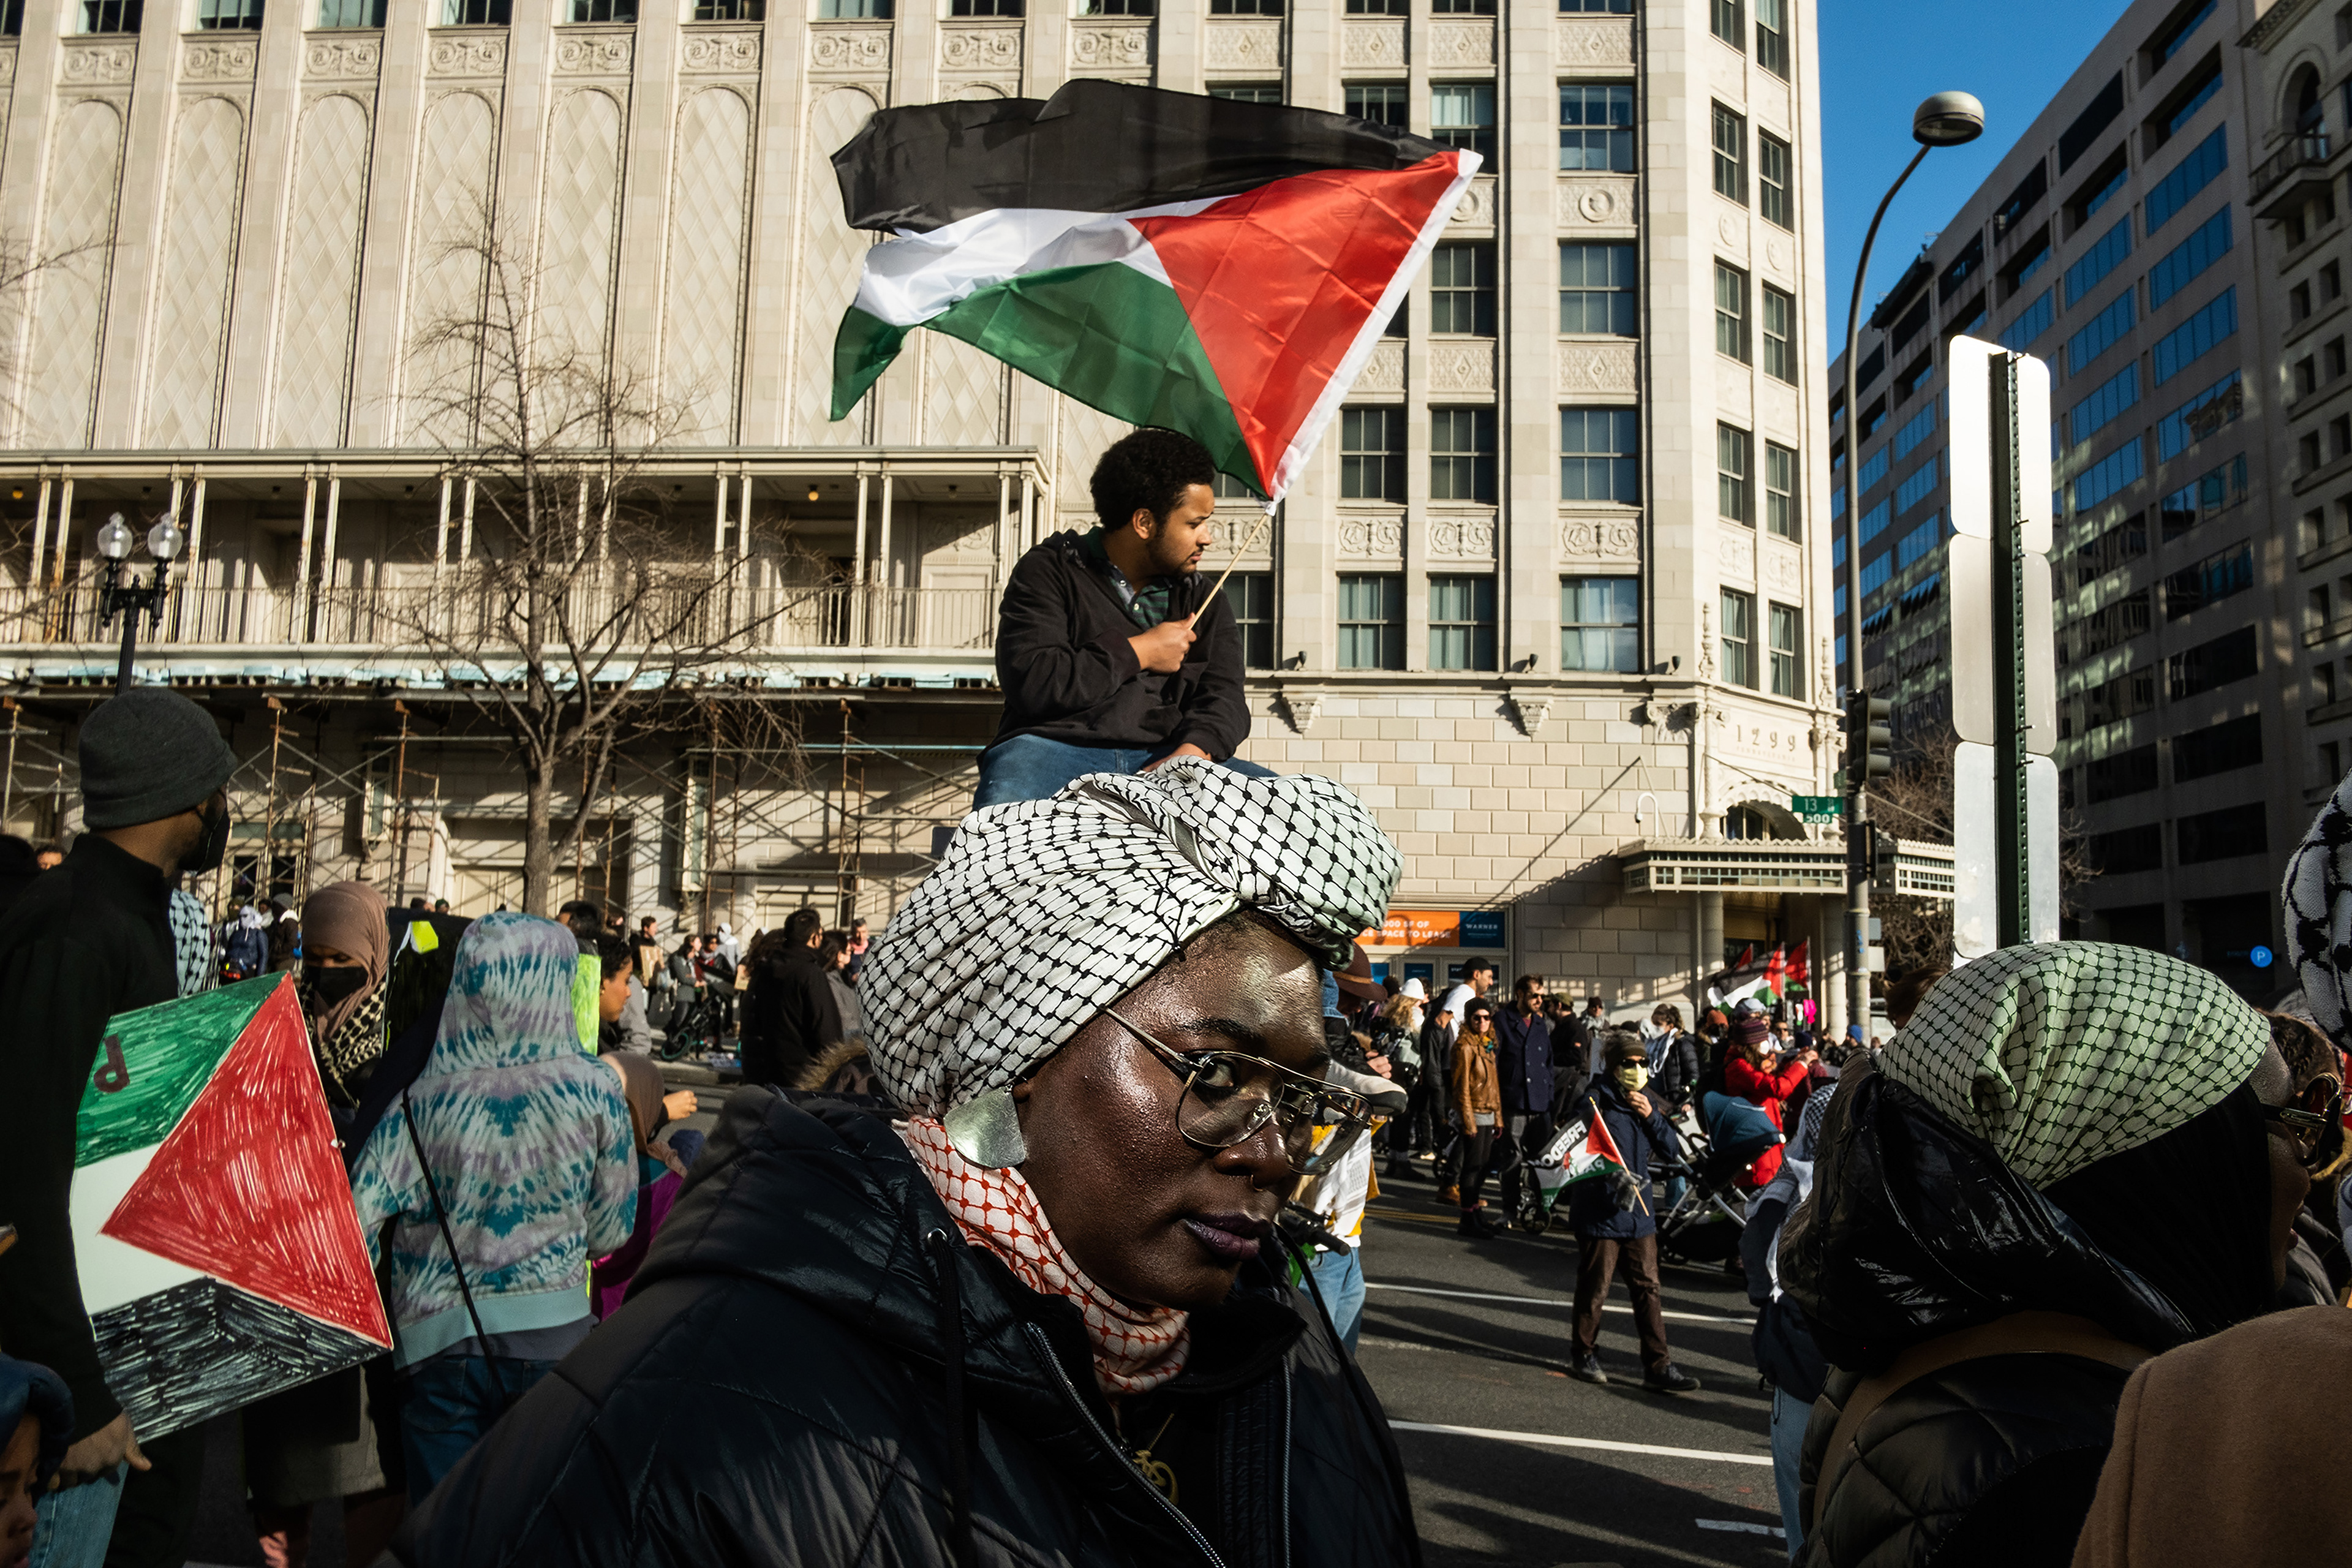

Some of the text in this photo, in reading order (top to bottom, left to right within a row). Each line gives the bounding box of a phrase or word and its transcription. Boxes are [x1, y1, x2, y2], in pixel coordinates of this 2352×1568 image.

[1736, 724, 1796, 752] 1299
[1804, 798, 1817, 812] 13
[1806, 813, 1830, 823] 500
[2257, 951, 2266, 961] P
